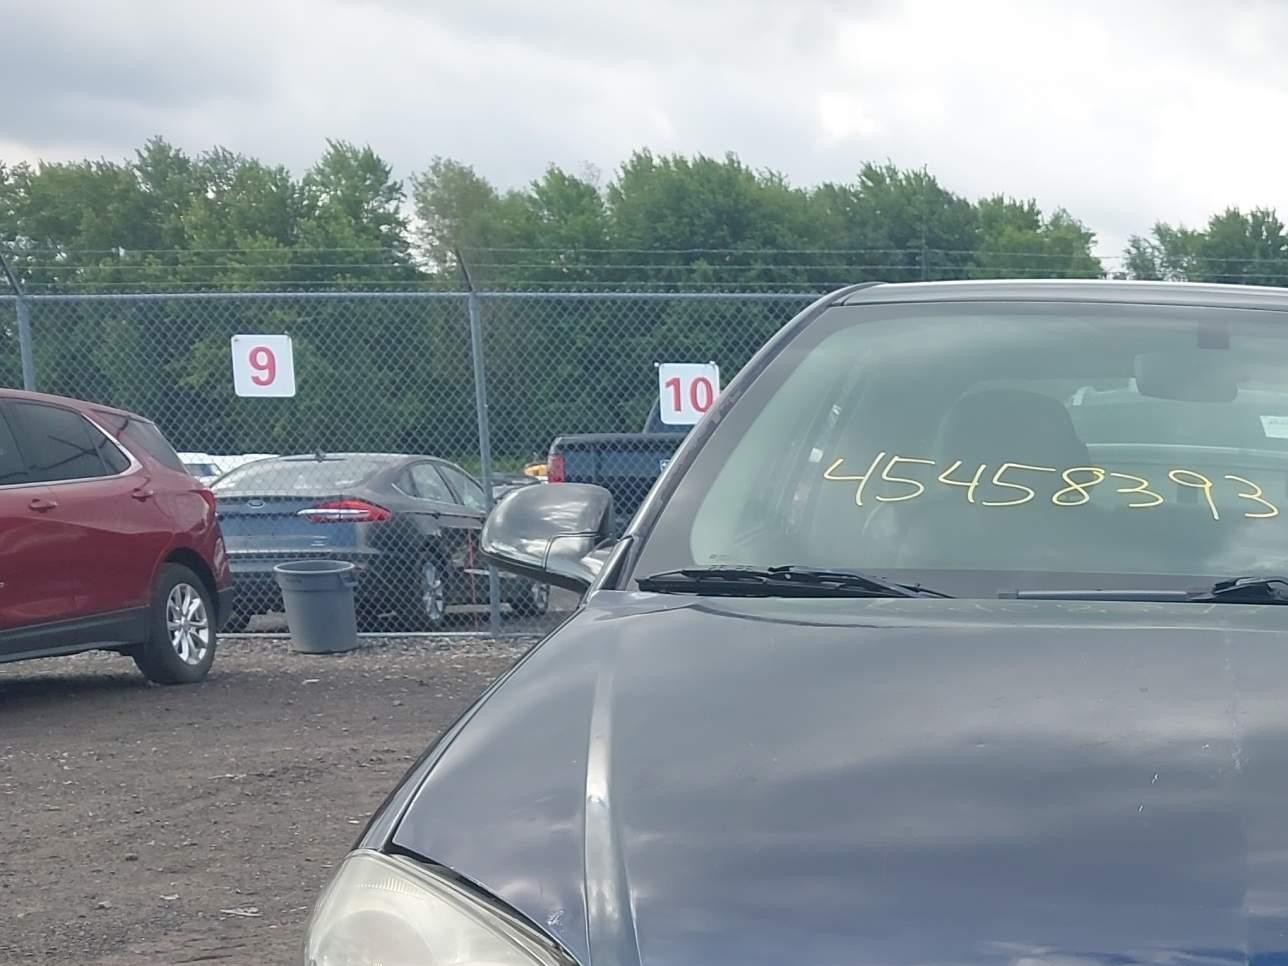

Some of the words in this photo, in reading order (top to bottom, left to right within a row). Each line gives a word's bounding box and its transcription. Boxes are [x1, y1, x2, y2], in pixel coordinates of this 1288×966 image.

[248, 346, 277, 387] 9
[664, 376, 715, 413] 10
[823, 451, 1279, 521] 45458393
